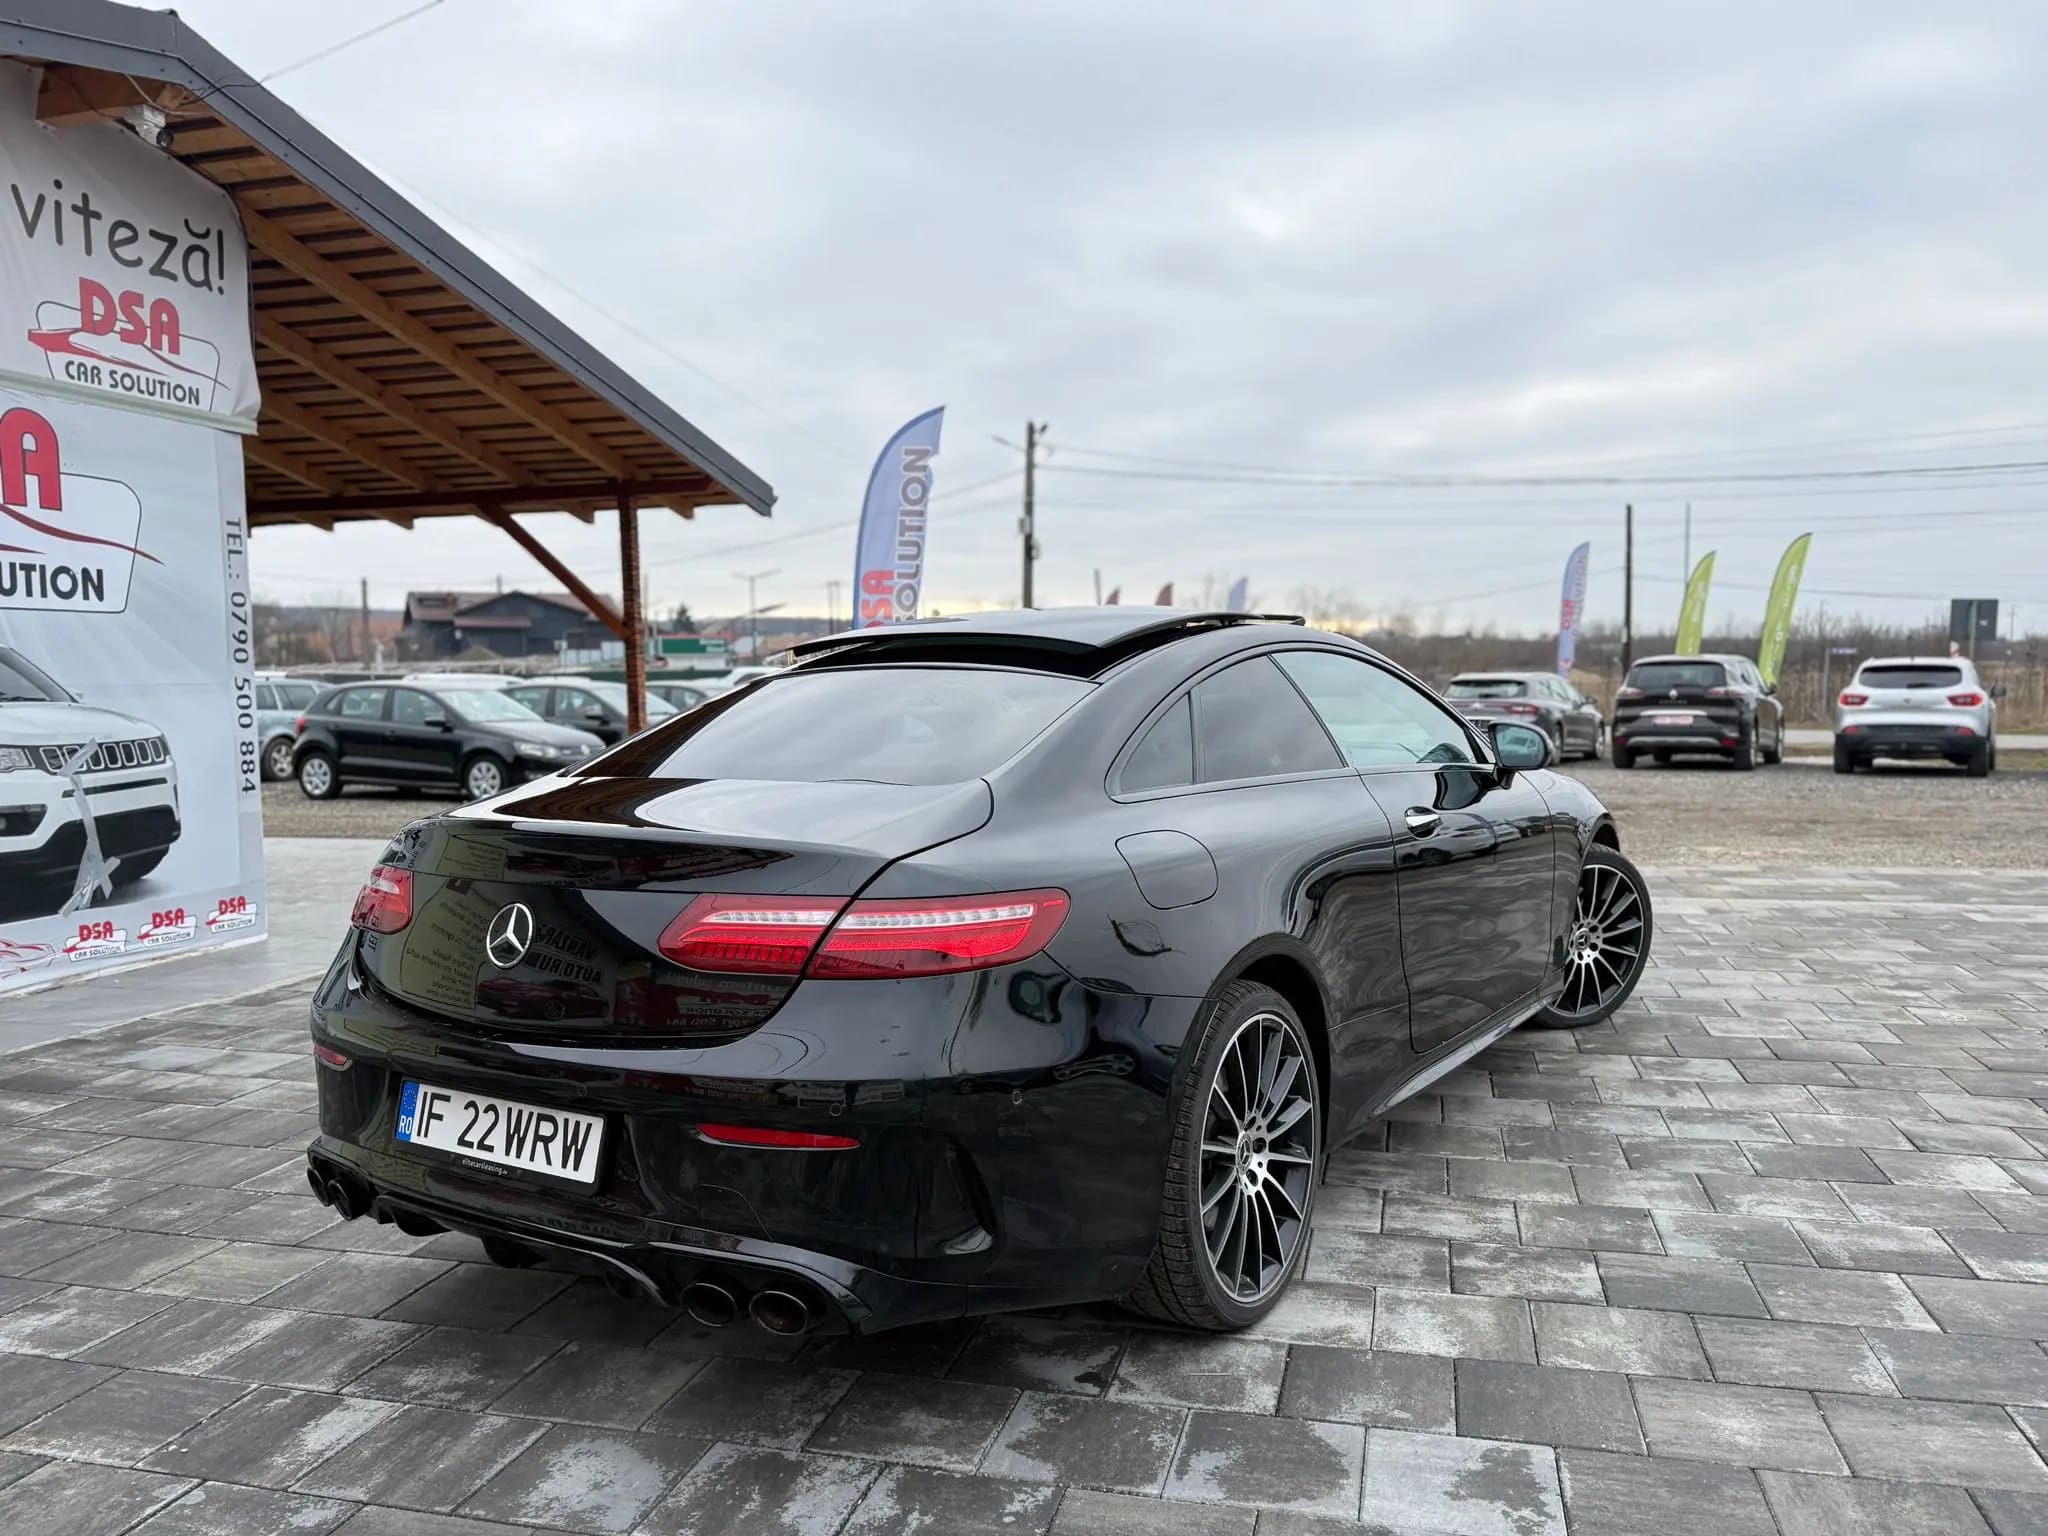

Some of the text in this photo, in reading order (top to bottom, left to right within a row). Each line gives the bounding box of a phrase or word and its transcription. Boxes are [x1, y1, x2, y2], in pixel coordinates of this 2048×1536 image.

[10, 179, 225, 295] viteză!
[79, 276, 181, 356] DSA
[65, 359, 200, 406] CAR SOLUTION
[895, 447, 930, 622] OLUTION
[861, 570, 894, 628] SA
[230, 592, 249, 664] 0790
[235, 677, 253, 729] 500
[240, 741, 256, 794] 884
[79, 920, 113, 942] DSA
[152, 908, 185, 929] DSA
[218, 896, 247, 915] DSA
[398, 1114, 413, 1135] RO
[416, 1091, 451, 1138] IF
